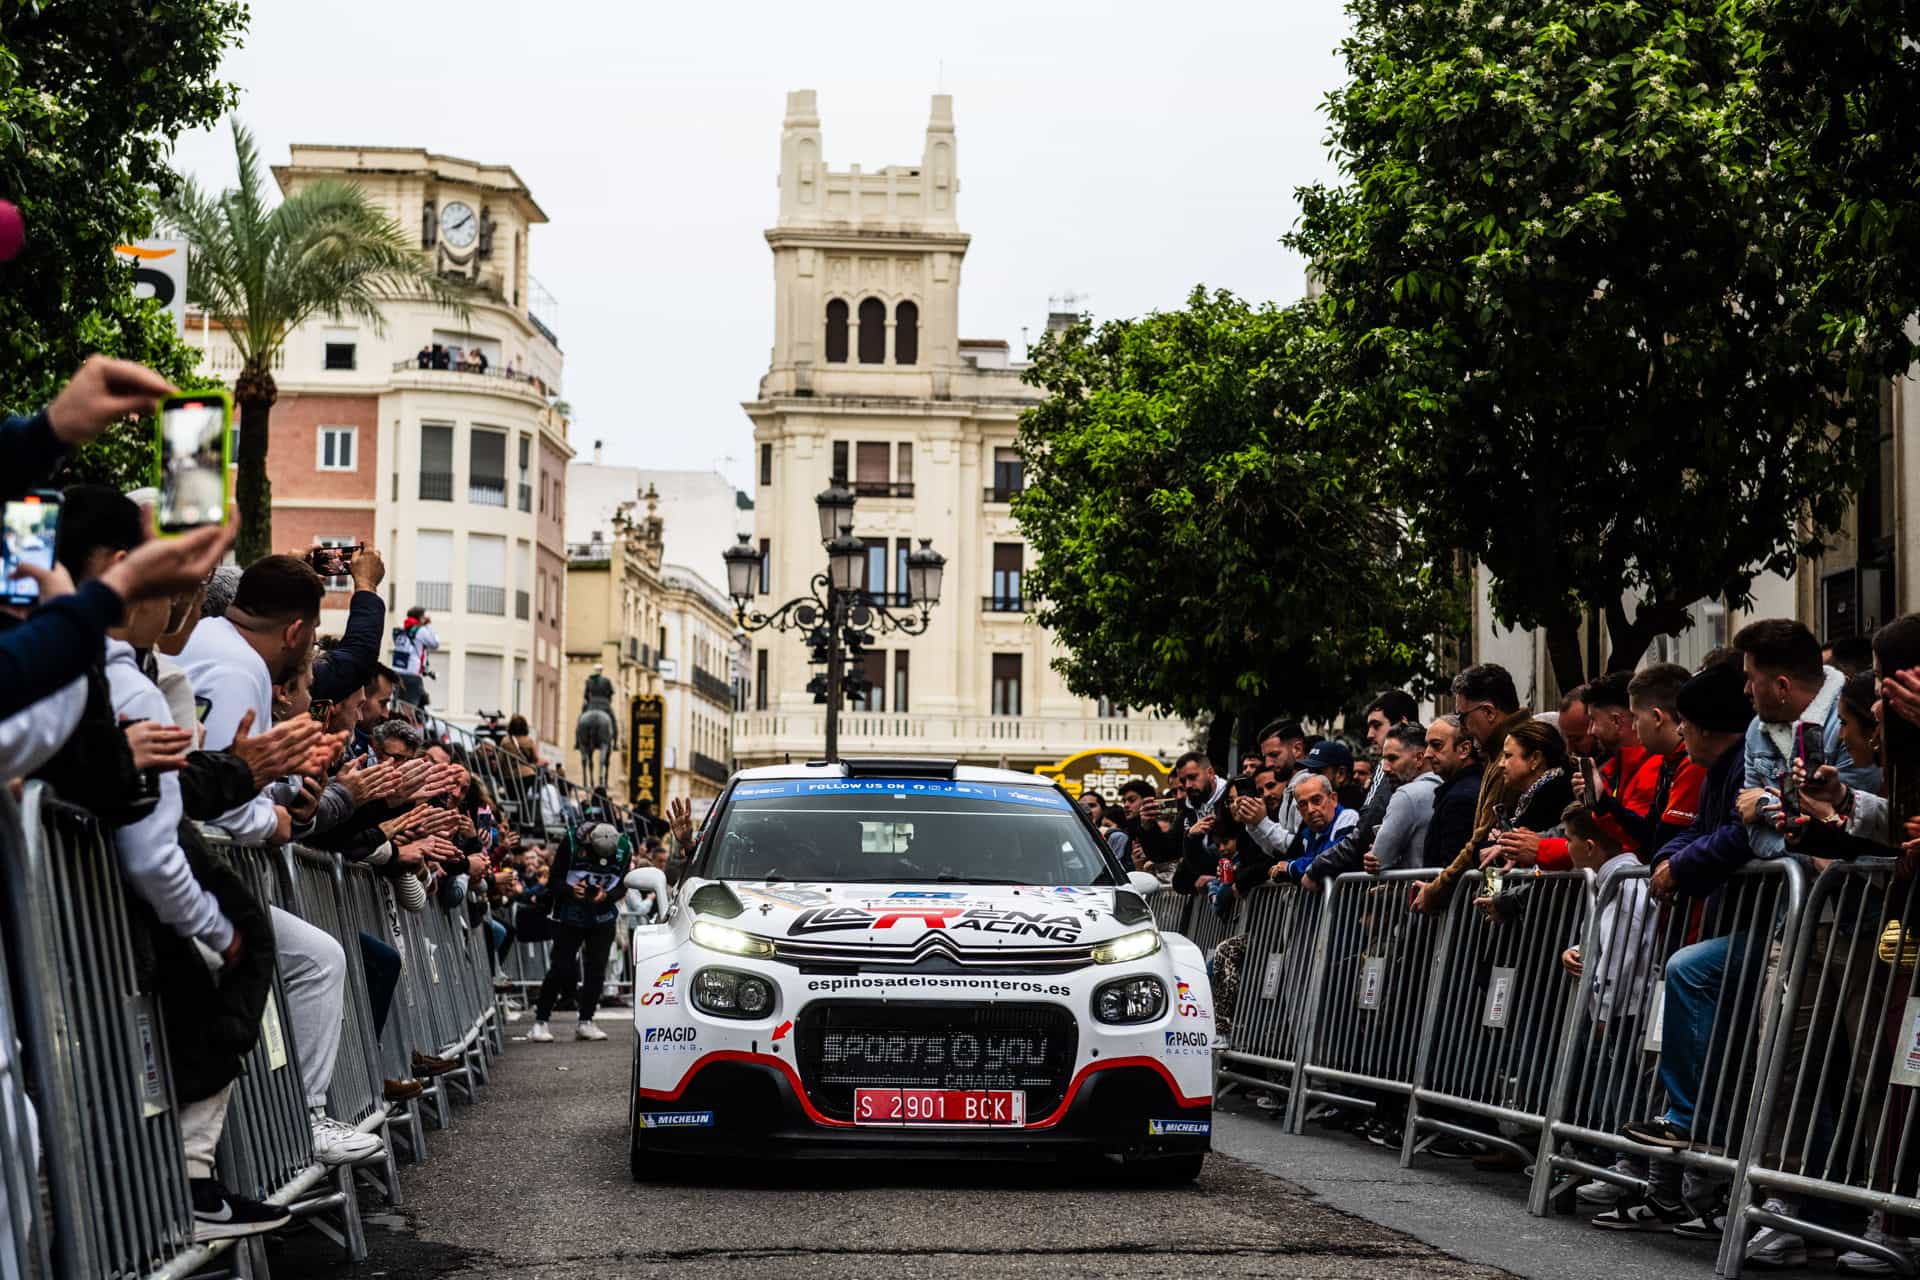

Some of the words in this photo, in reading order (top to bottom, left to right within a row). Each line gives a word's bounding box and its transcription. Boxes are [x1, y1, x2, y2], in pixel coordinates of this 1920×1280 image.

[808, 782, 862, 791] FOLLOW
[866, 782, 883, 790] US
[887, 782, 905, 790] ON
[807, 976, 1071, 997] espinosadelosmonteros.es
[656, 1026, 697, 1042] PAGID
[1176, 1031, 1208, 1047] PAGID
[821, 1033, 946, 1064] SPORTS
[860, 1096, 873, 1118] S
[890, 1095, 946, 1119] 2901
[965, 1098, 1006, 1120] BCK
[657, 1113, 710, 1124] MICHELIN
[1165, 1122, 1210, 1133] MICHELIN
